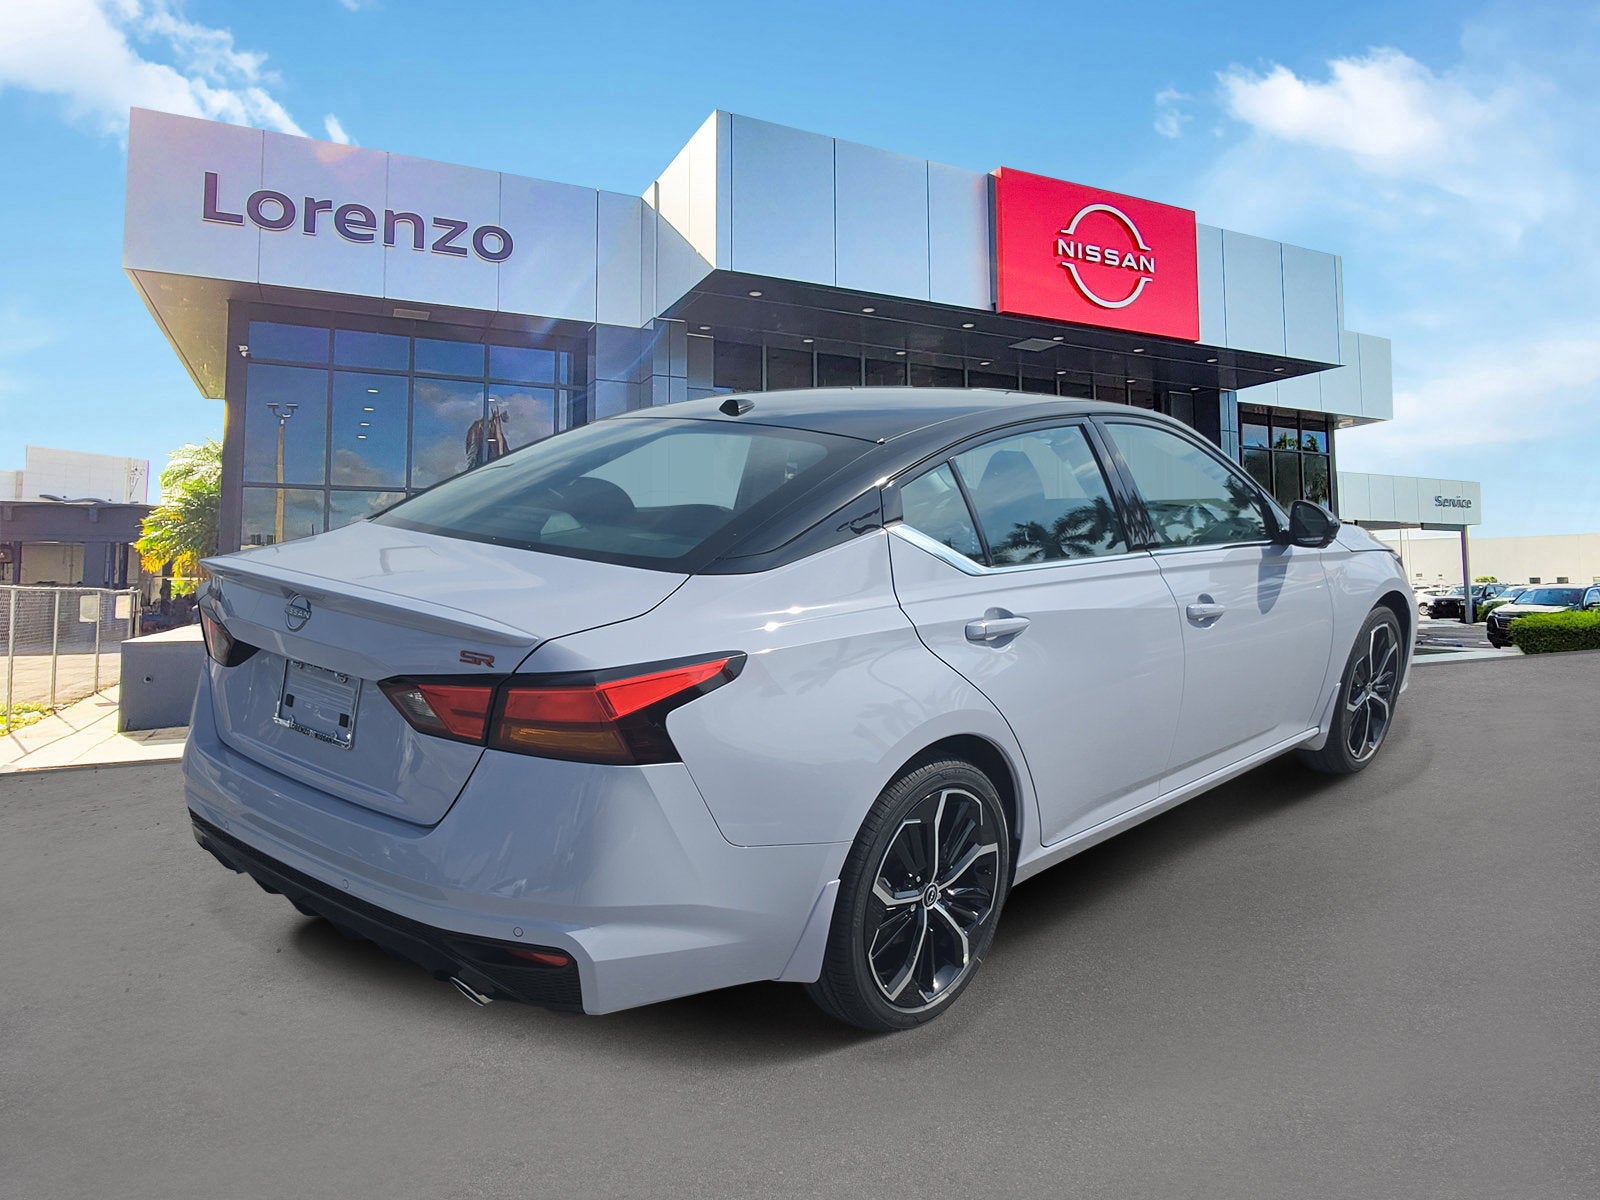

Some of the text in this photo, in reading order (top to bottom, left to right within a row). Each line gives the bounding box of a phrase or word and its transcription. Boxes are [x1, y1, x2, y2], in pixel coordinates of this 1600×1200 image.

[203, 171, 514, 262] Lorenzo
[1057, 238, 1155, 273] NISSAN
[1434, 495, 1472, 508] Service
[285, 606, 312, 619] SSAN
[460, 650, 495, 668] SR
